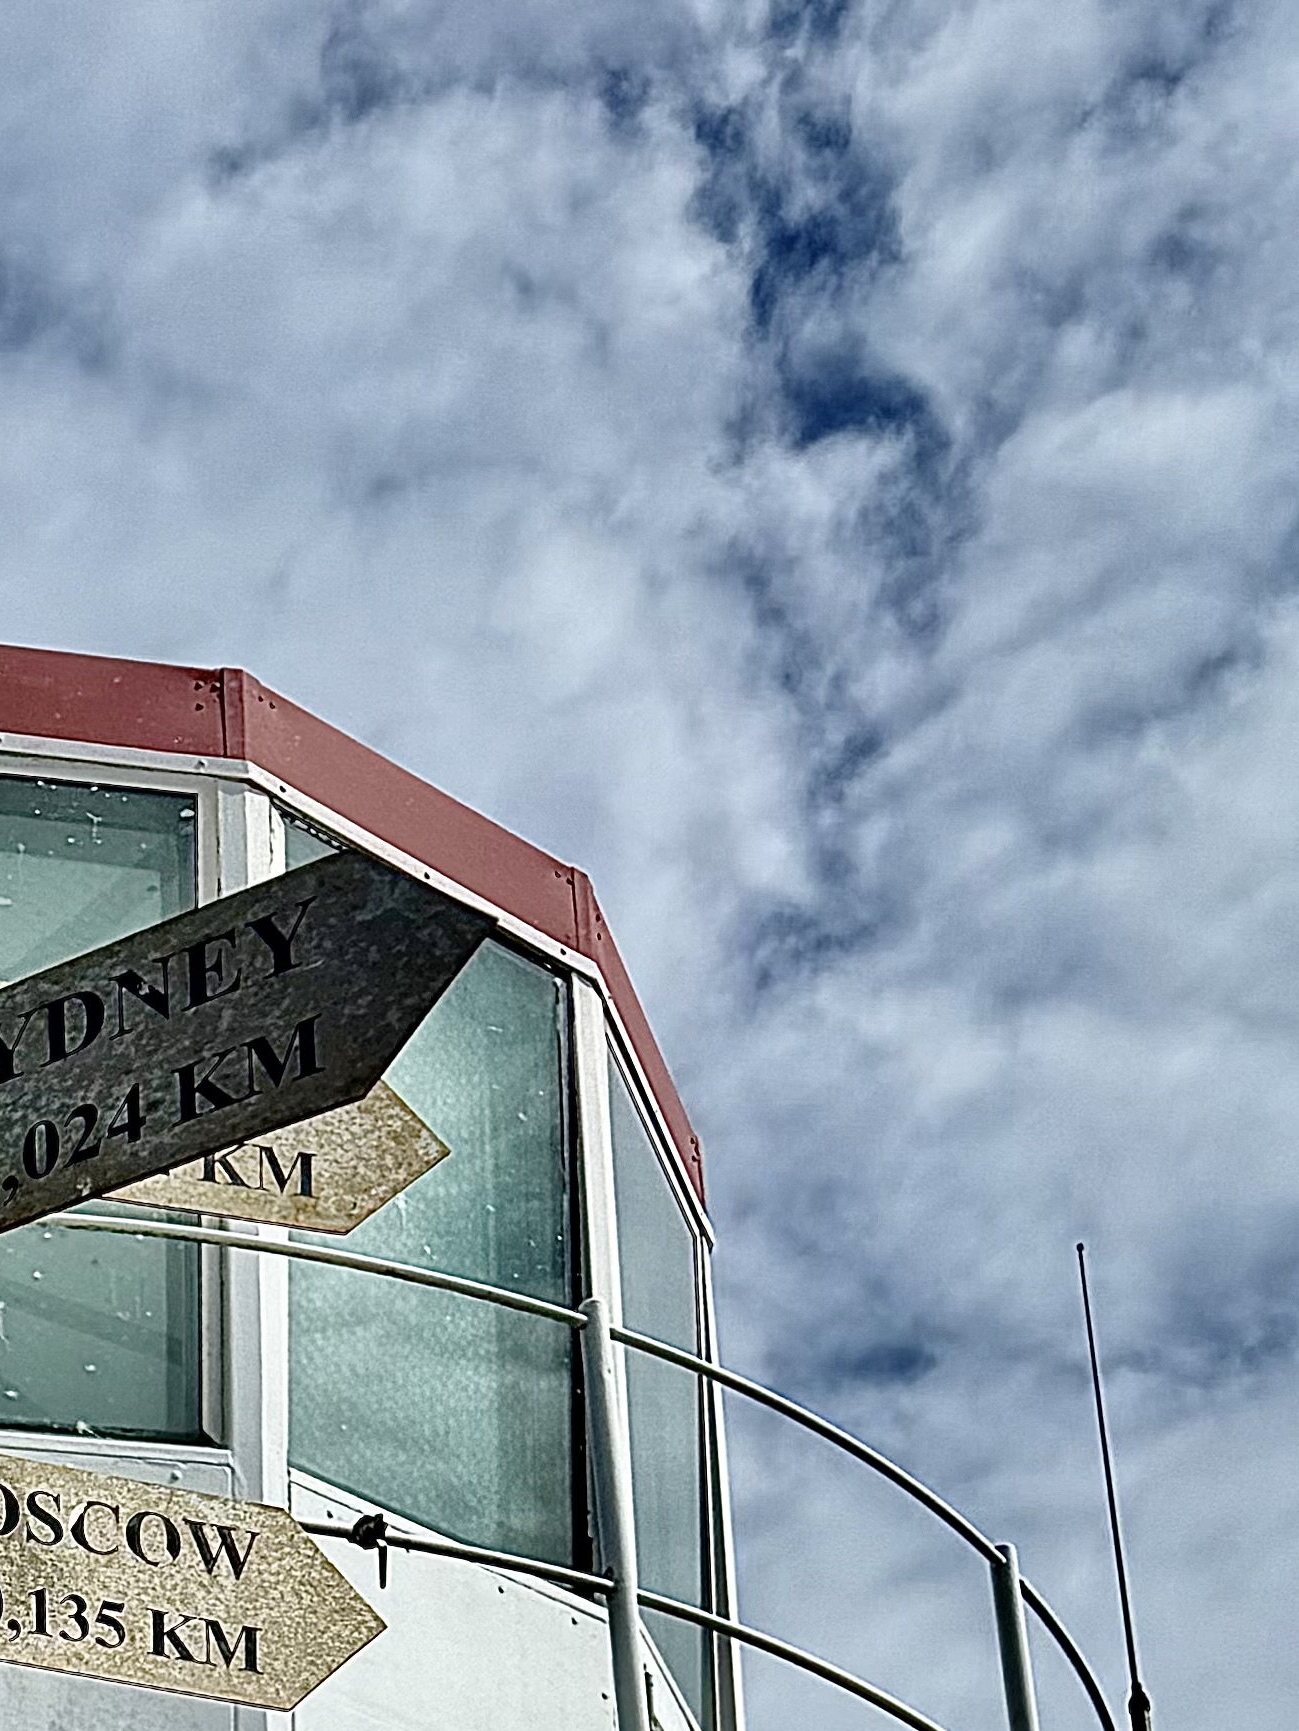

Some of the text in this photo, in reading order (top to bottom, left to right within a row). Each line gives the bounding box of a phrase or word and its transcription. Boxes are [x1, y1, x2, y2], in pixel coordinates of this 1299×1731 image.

[171, 1013, 326, 1127] KM
[199, 1143, 316, 1199] KM
[147, 1608, 264, 1675] KM
